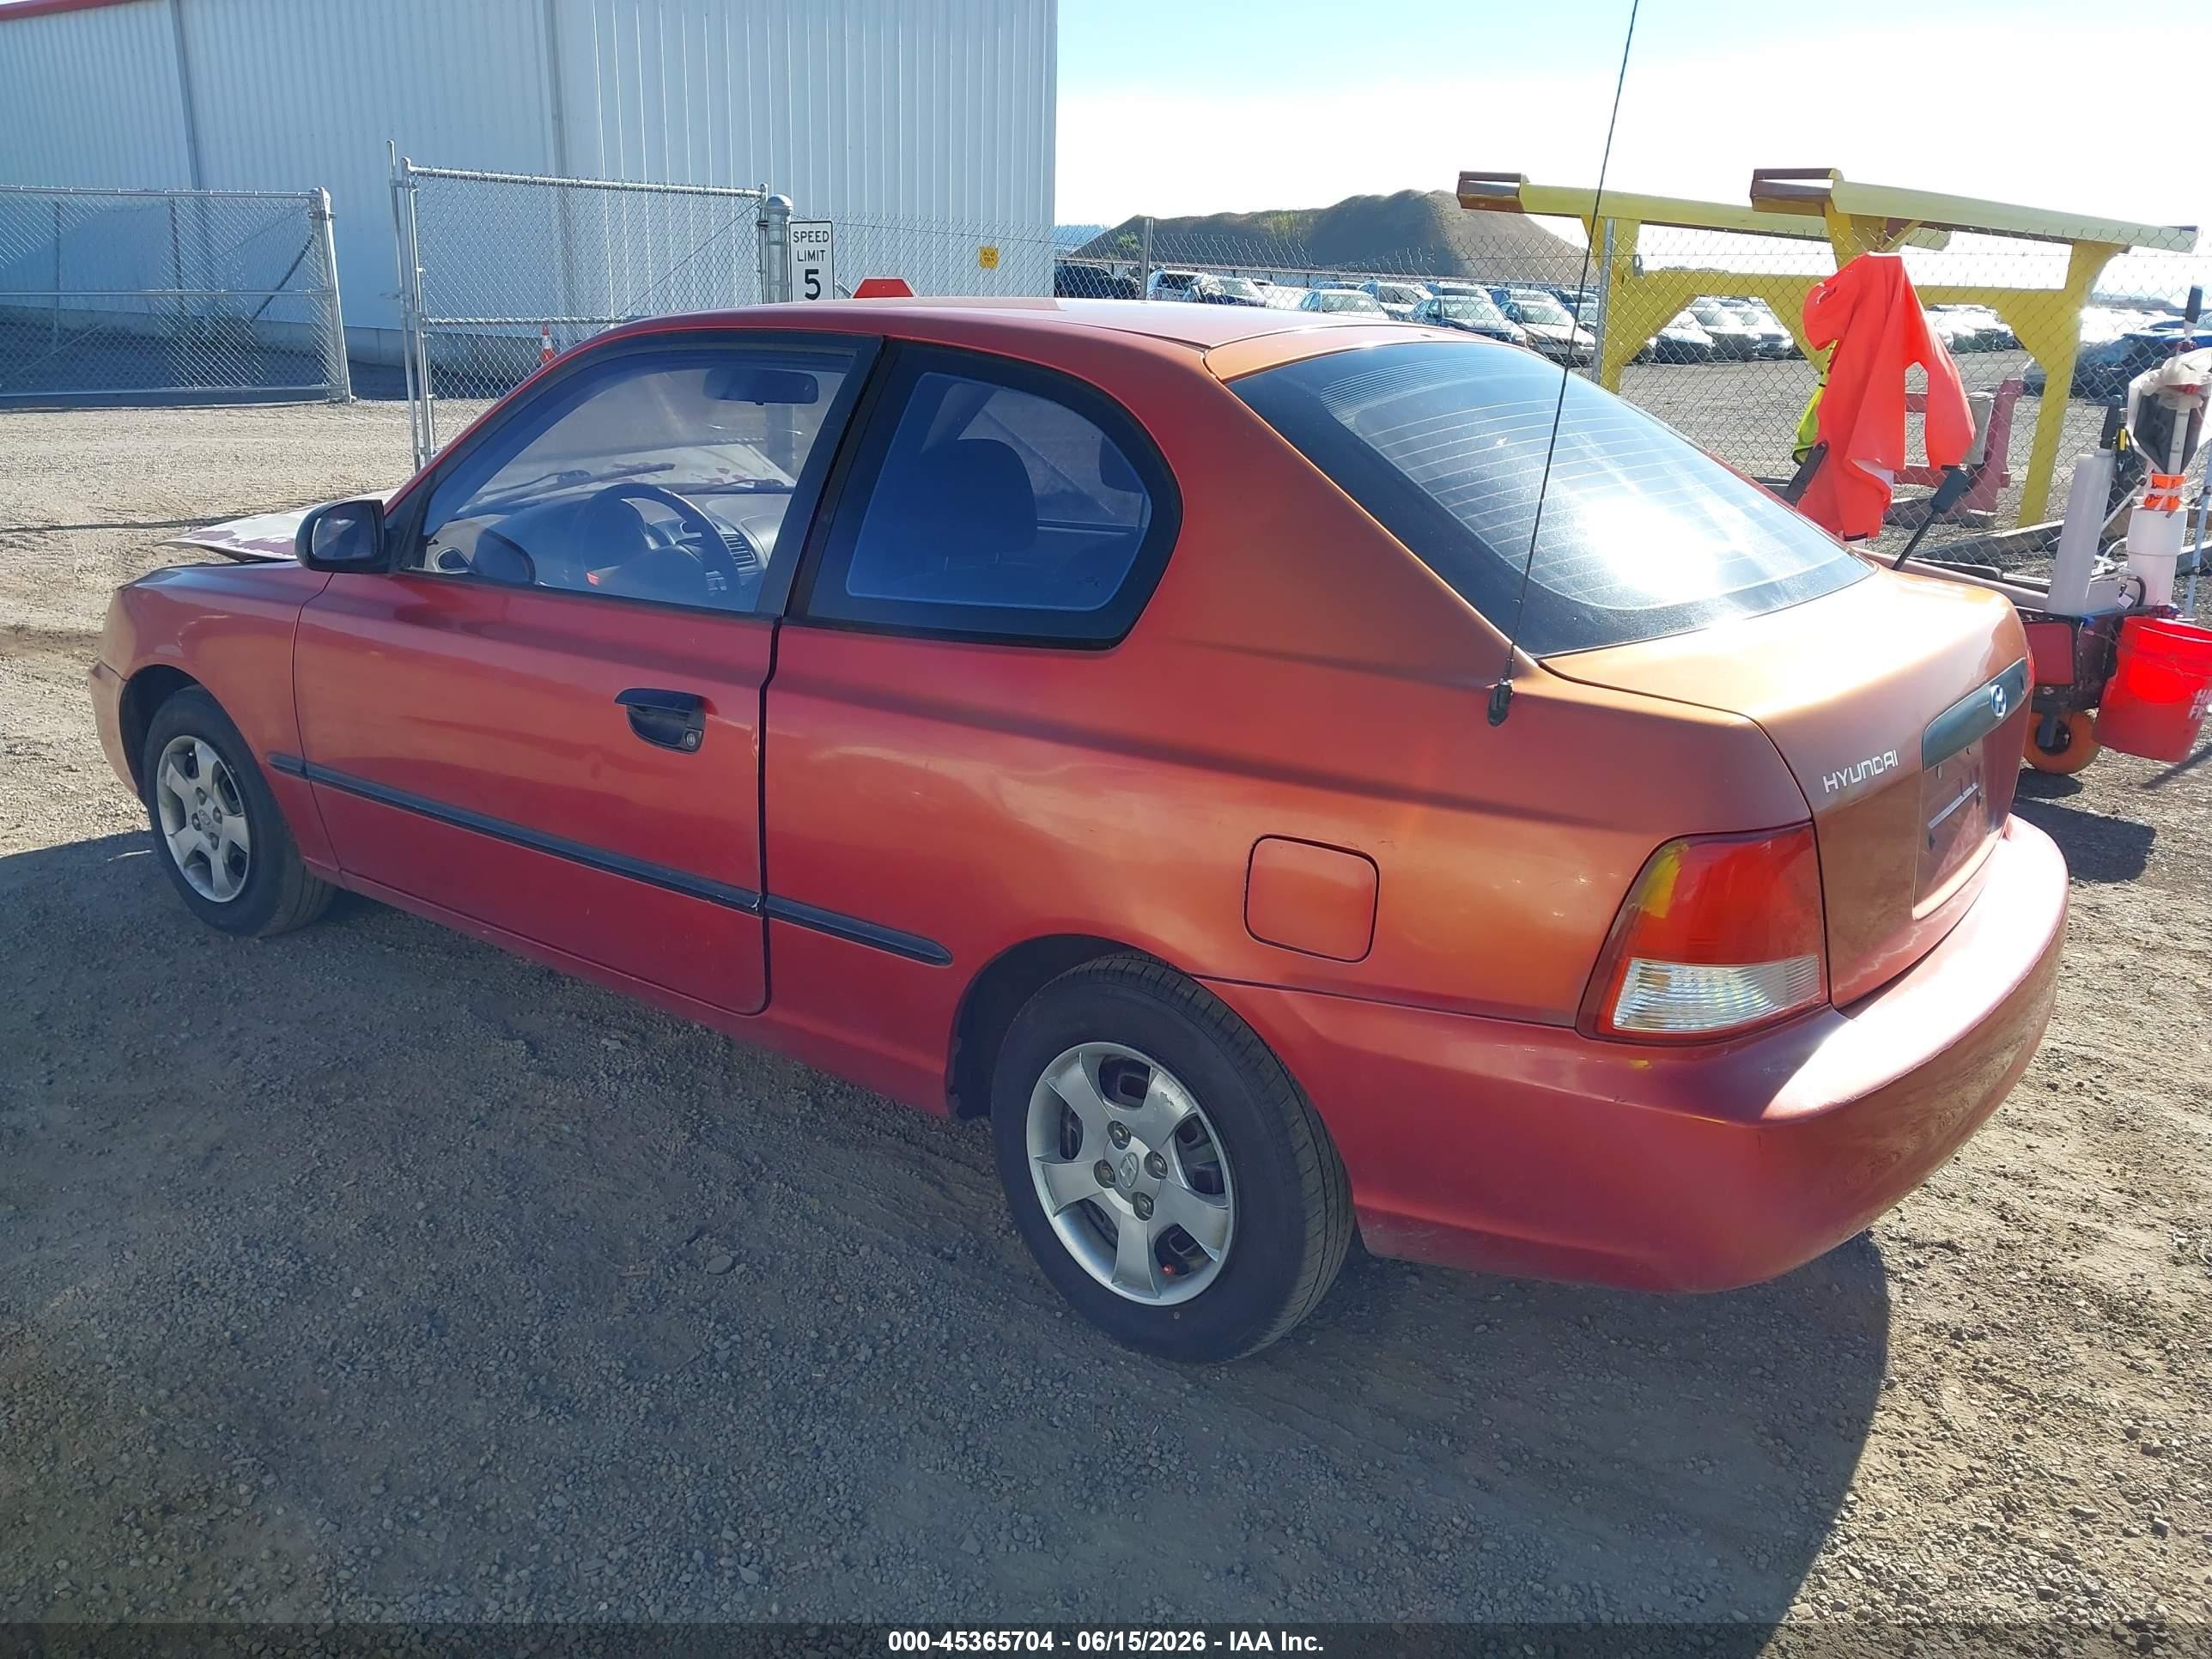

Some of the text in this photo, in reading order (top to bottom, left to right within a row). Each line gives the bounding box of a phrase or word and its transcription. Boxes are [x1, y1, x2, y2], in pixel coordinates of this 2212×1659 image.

[793, 230, 830, 243] SPEED
[797, 249, 826, 262] LIMIT
[805, 268, 822, 301] 5
[1822, 749, 1899, 793] HYUNDAI
